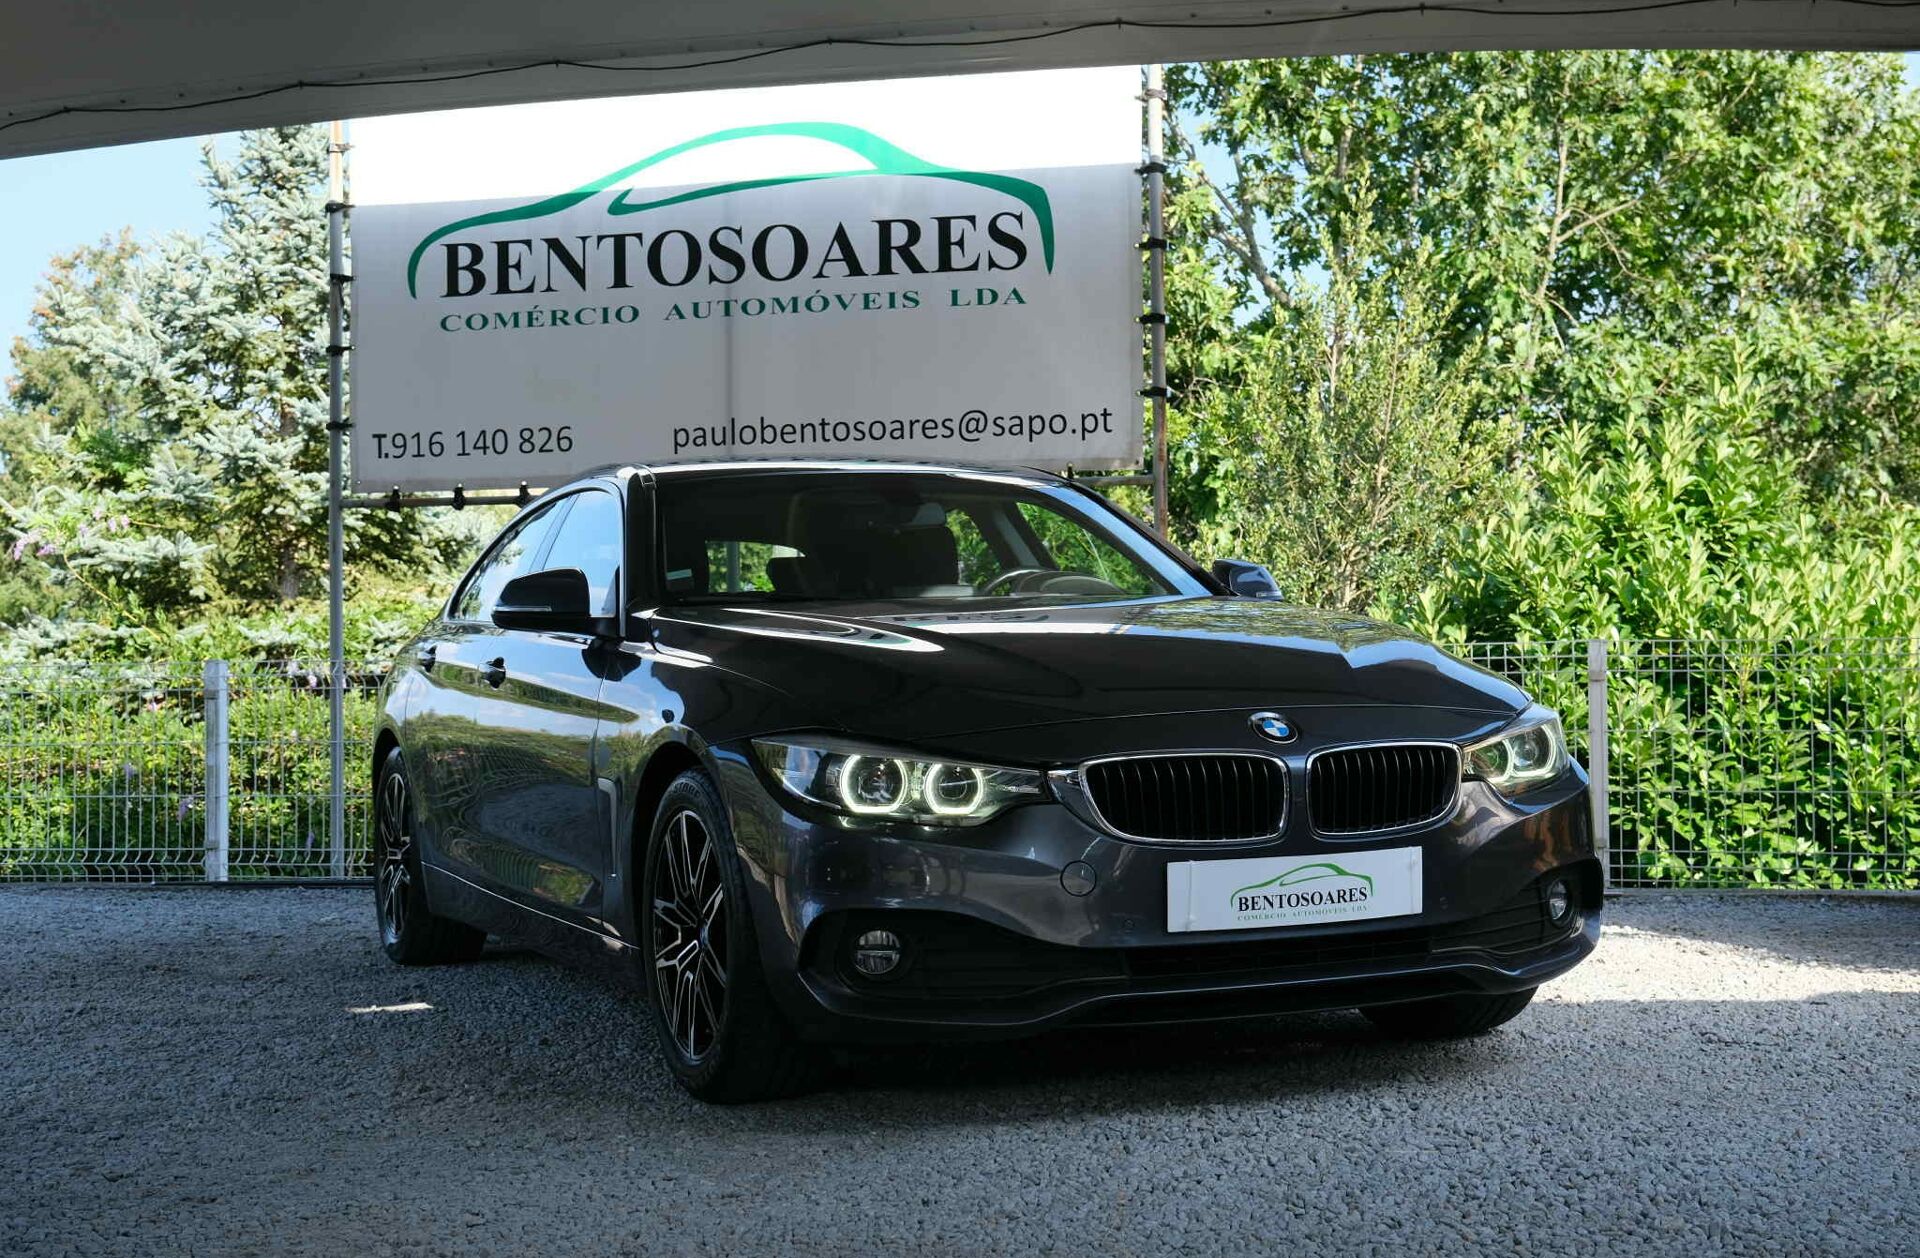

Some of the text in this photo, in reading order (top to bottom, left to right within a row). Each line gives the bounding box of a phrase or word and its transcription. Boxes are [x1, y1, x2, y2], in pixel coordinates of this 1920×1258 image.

[439, 210, 1028, 299] BENTOSOARES
[439, 286, 1027, 332] COMÉRCIO AUTOMÓVEIS LDA
[456, 428, 509, 457] 140
[518, 425, 574, 454] 826
[672, 406, 1114, 454] paulobentosoares@sapo.pt
[1238, 886, 1368, 912] BENTOSOARES
